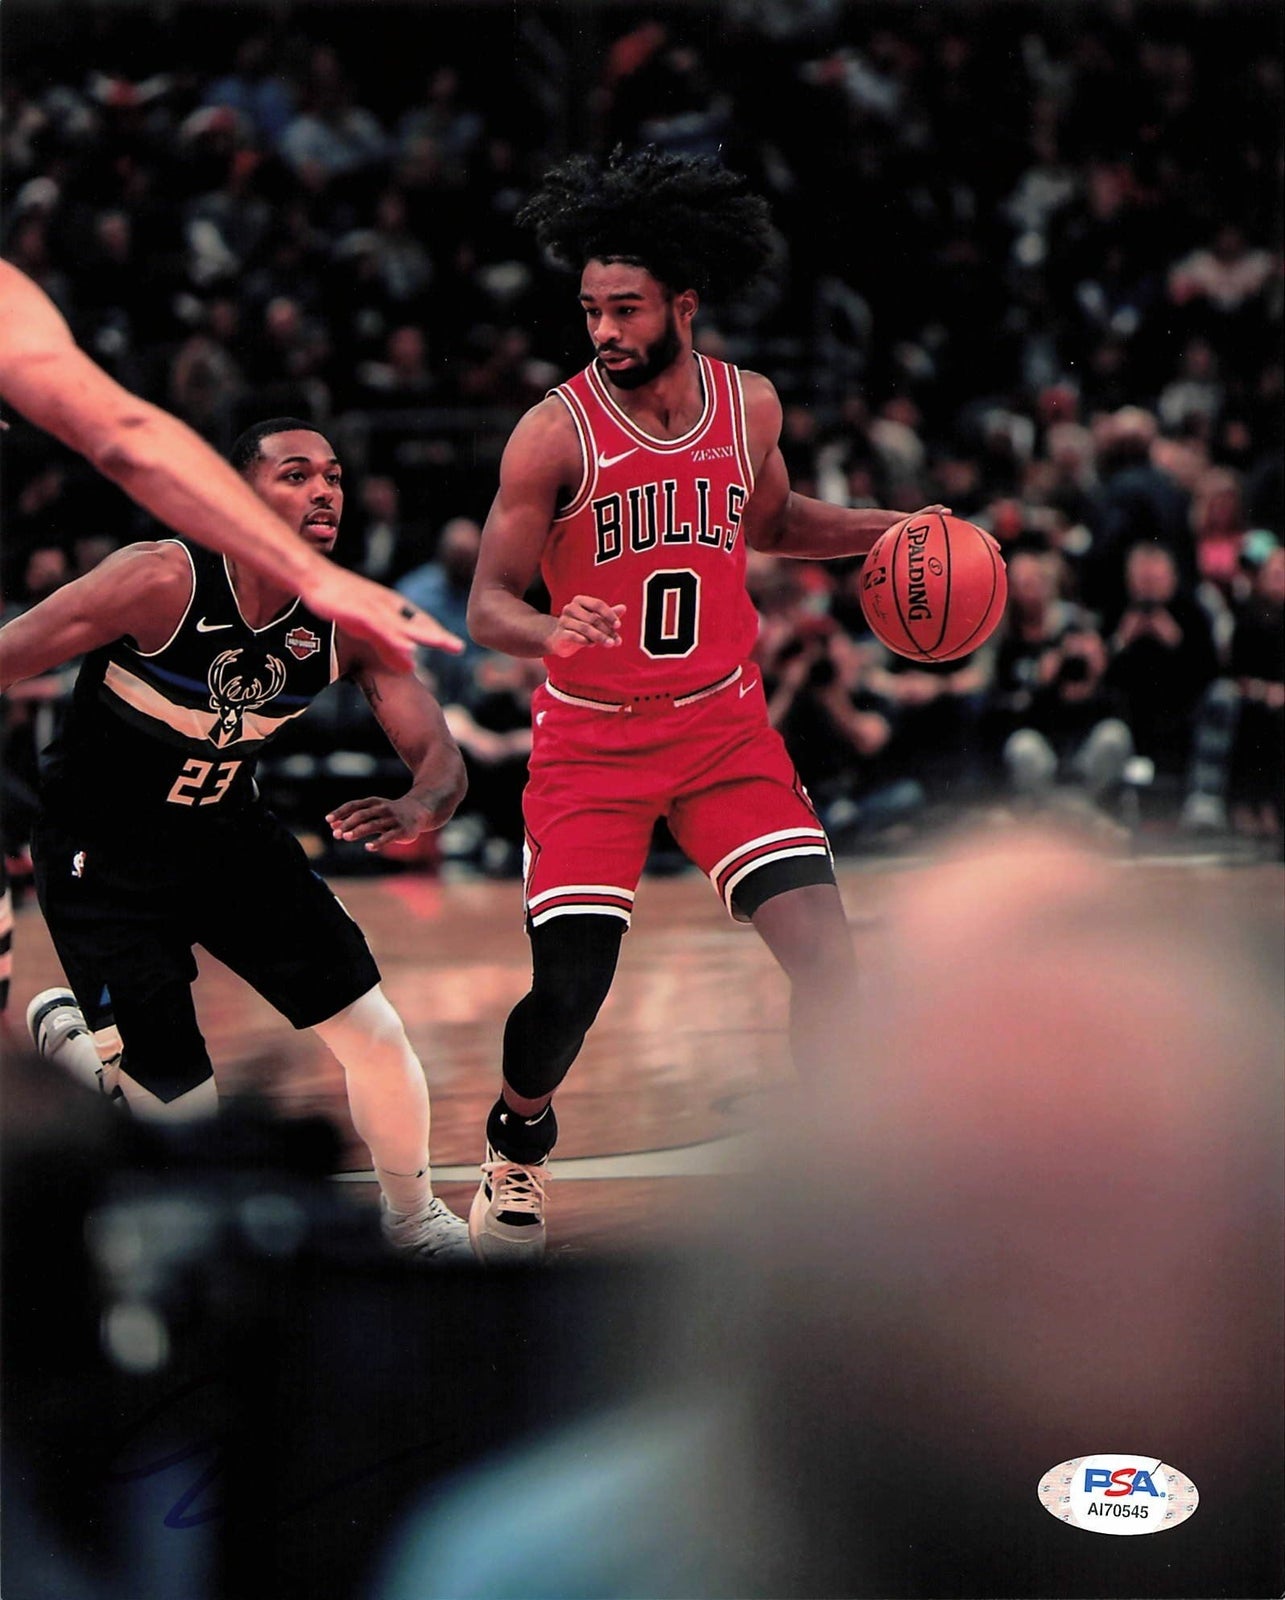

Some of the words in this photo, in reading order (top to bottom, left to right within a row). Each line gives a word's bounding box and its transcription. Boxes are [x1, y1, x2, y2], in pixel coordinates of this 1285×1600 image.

[691, 445, 734, 462] ZENNI
[591, 478, 747, 566] BULLS
[907, 525, 932, 621] SPALDING
[640, 568, 701, 659] 0
[166, 758, 242, 806] 23
[1087, 1502, 1149, 1519] AI70545
